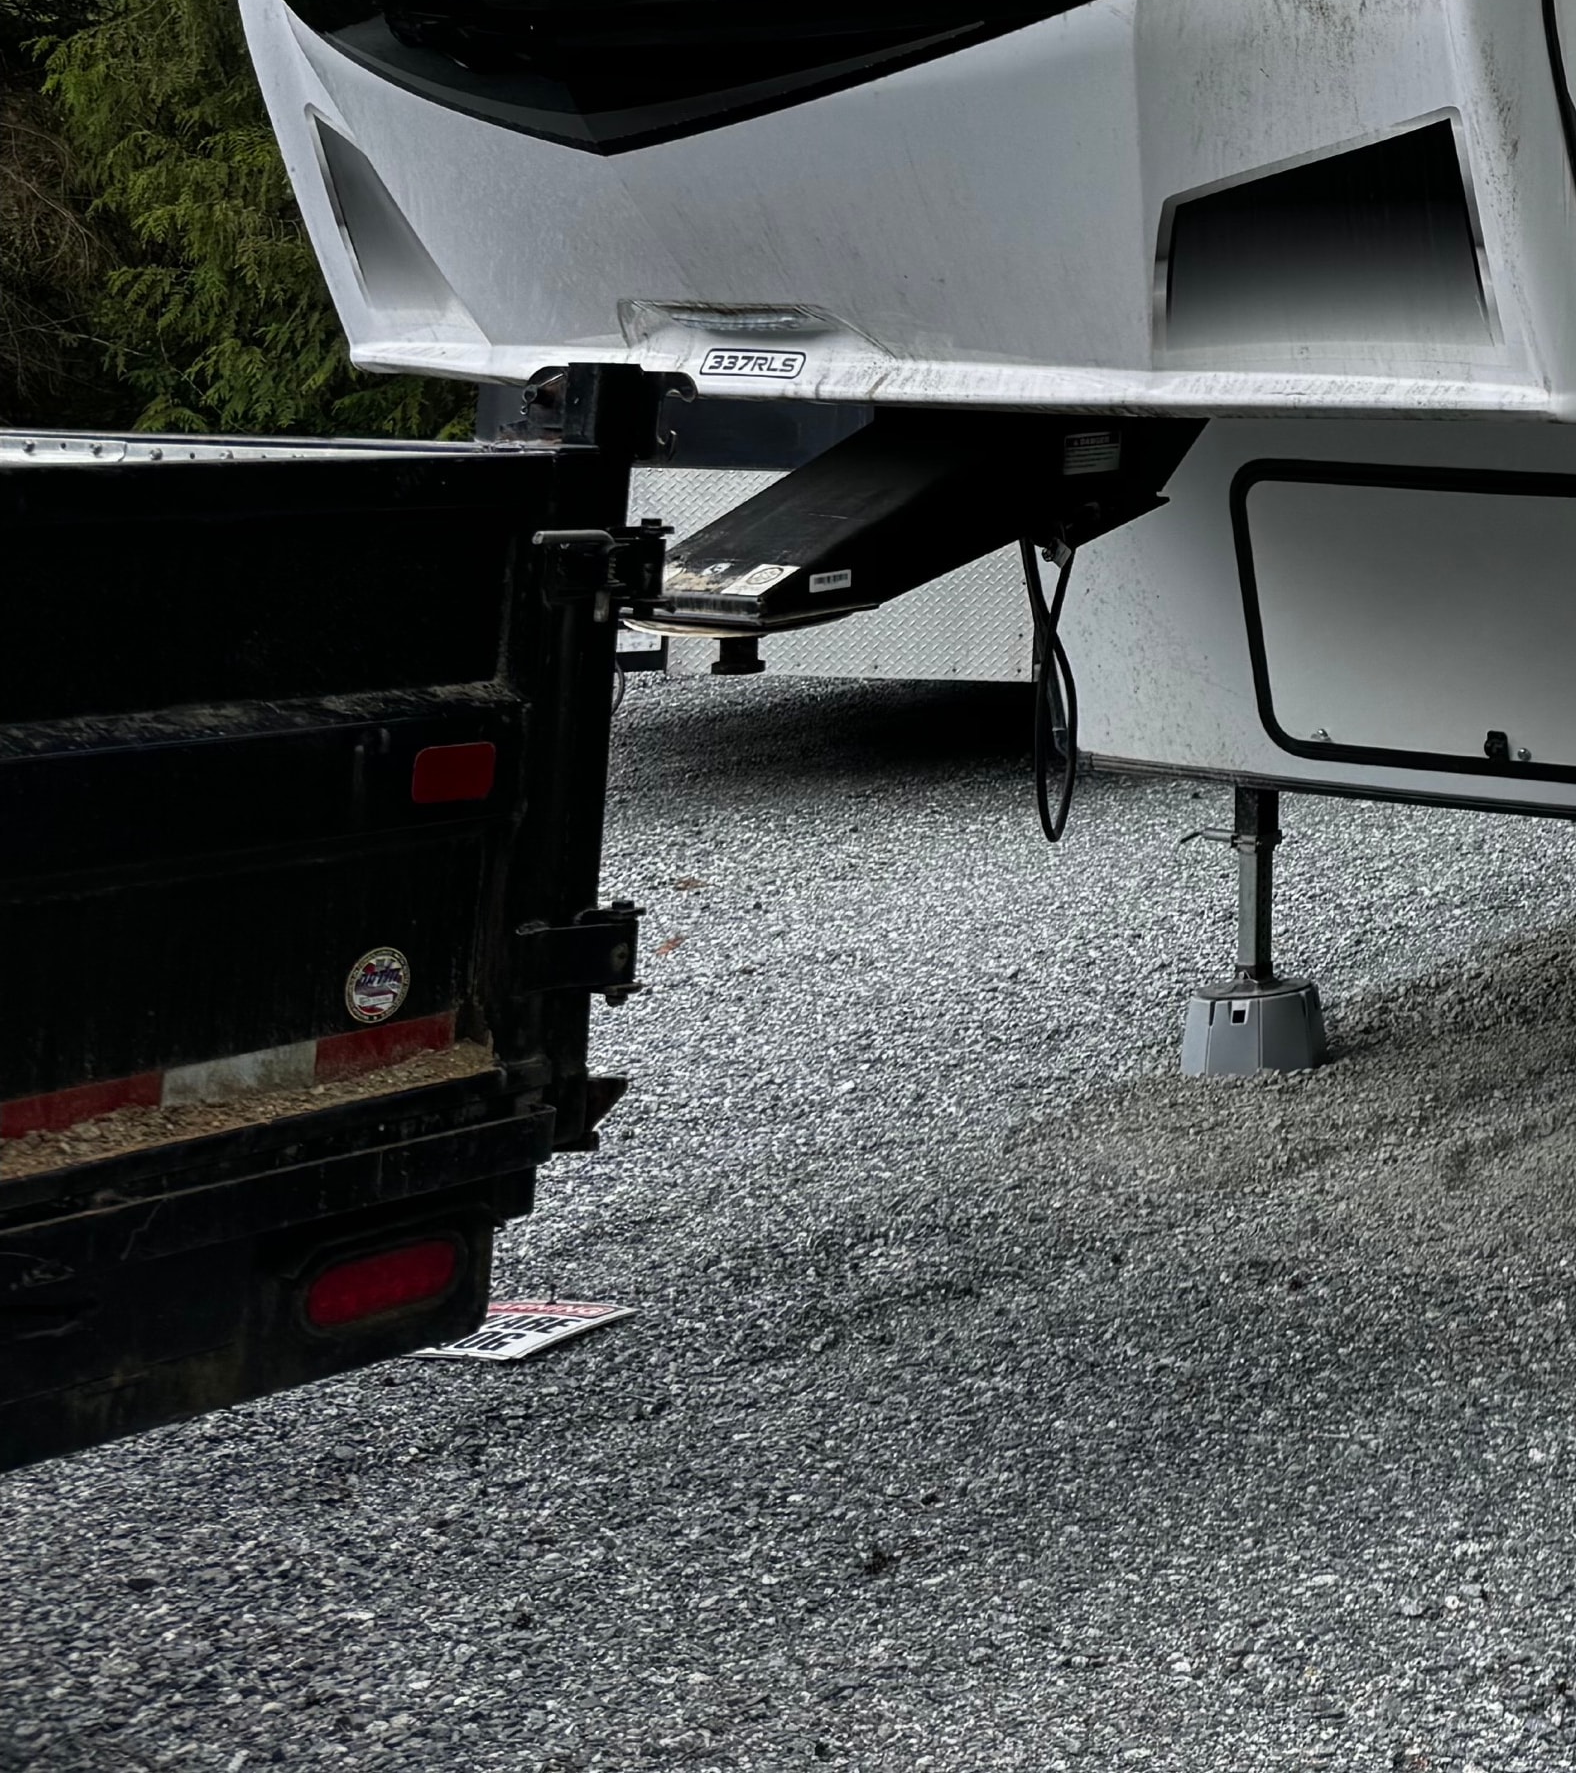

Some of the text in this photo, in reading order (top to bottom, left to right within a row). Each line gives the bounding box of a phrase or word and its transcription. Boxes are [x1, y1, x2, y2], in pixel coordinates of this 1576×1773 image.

[708, 355, 798, 373] 337RLS
[490, 1304, 604, 1315] ARNING
[452, 1331, 526, 1351] OG
